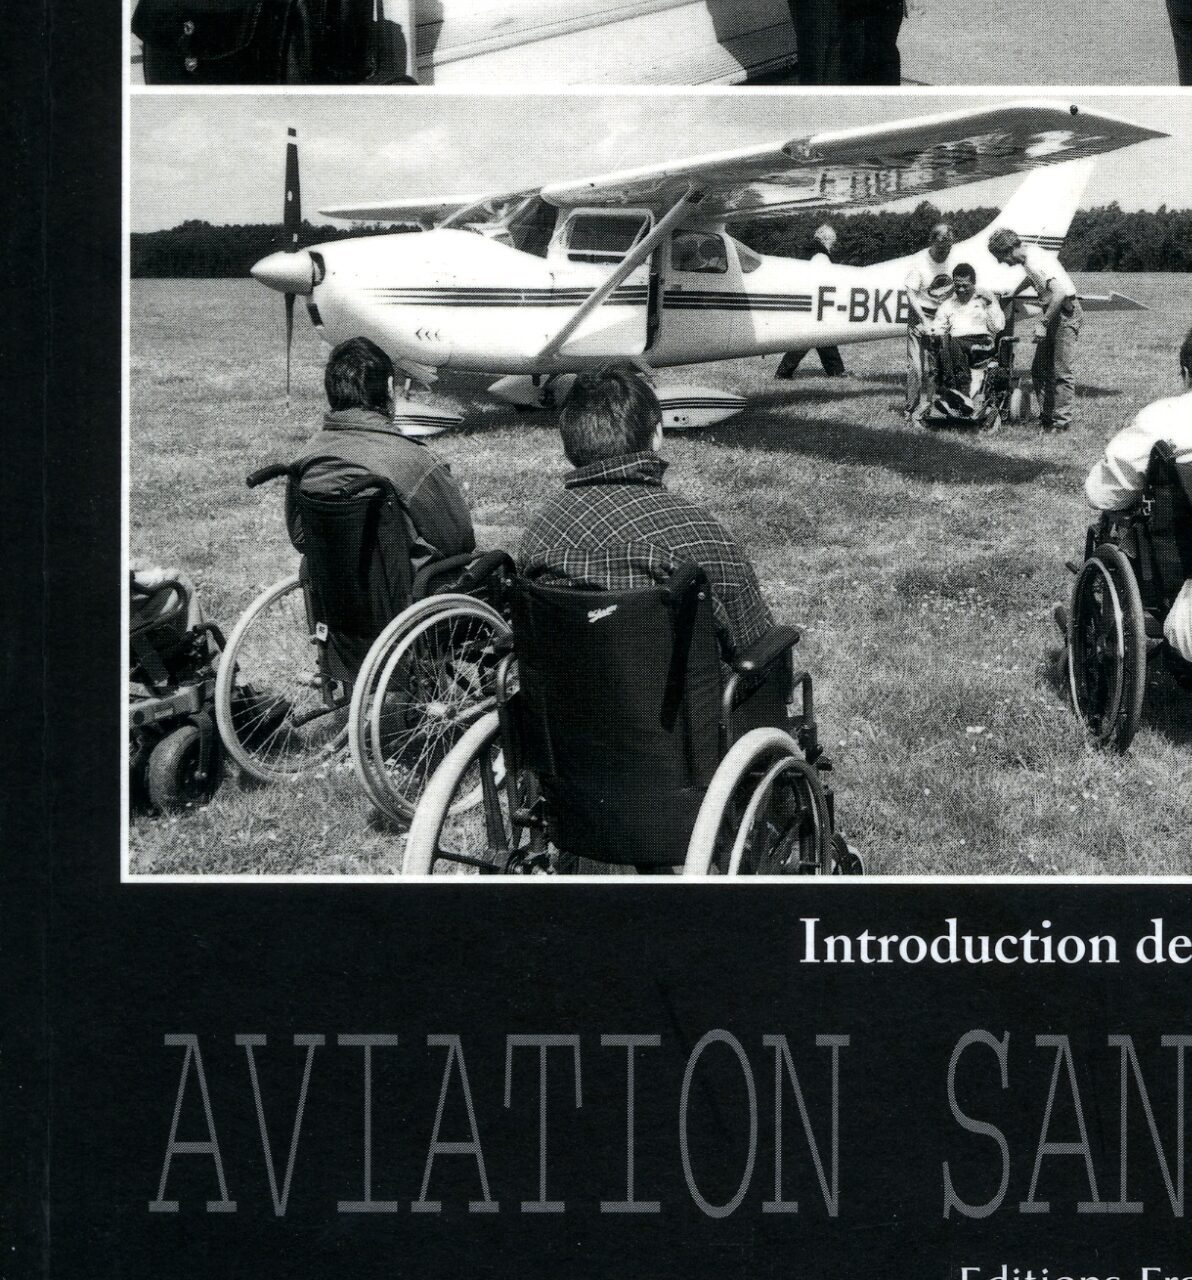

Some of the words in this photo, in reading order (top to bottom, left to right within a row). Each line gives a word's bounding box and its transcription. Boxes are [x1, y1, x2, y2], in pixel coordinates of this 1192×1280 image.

[801, 918, 1119, 963] Introduction
[1136, 918, 1192, 963] de
[149, 1029, 850, 1218] AVIATION
